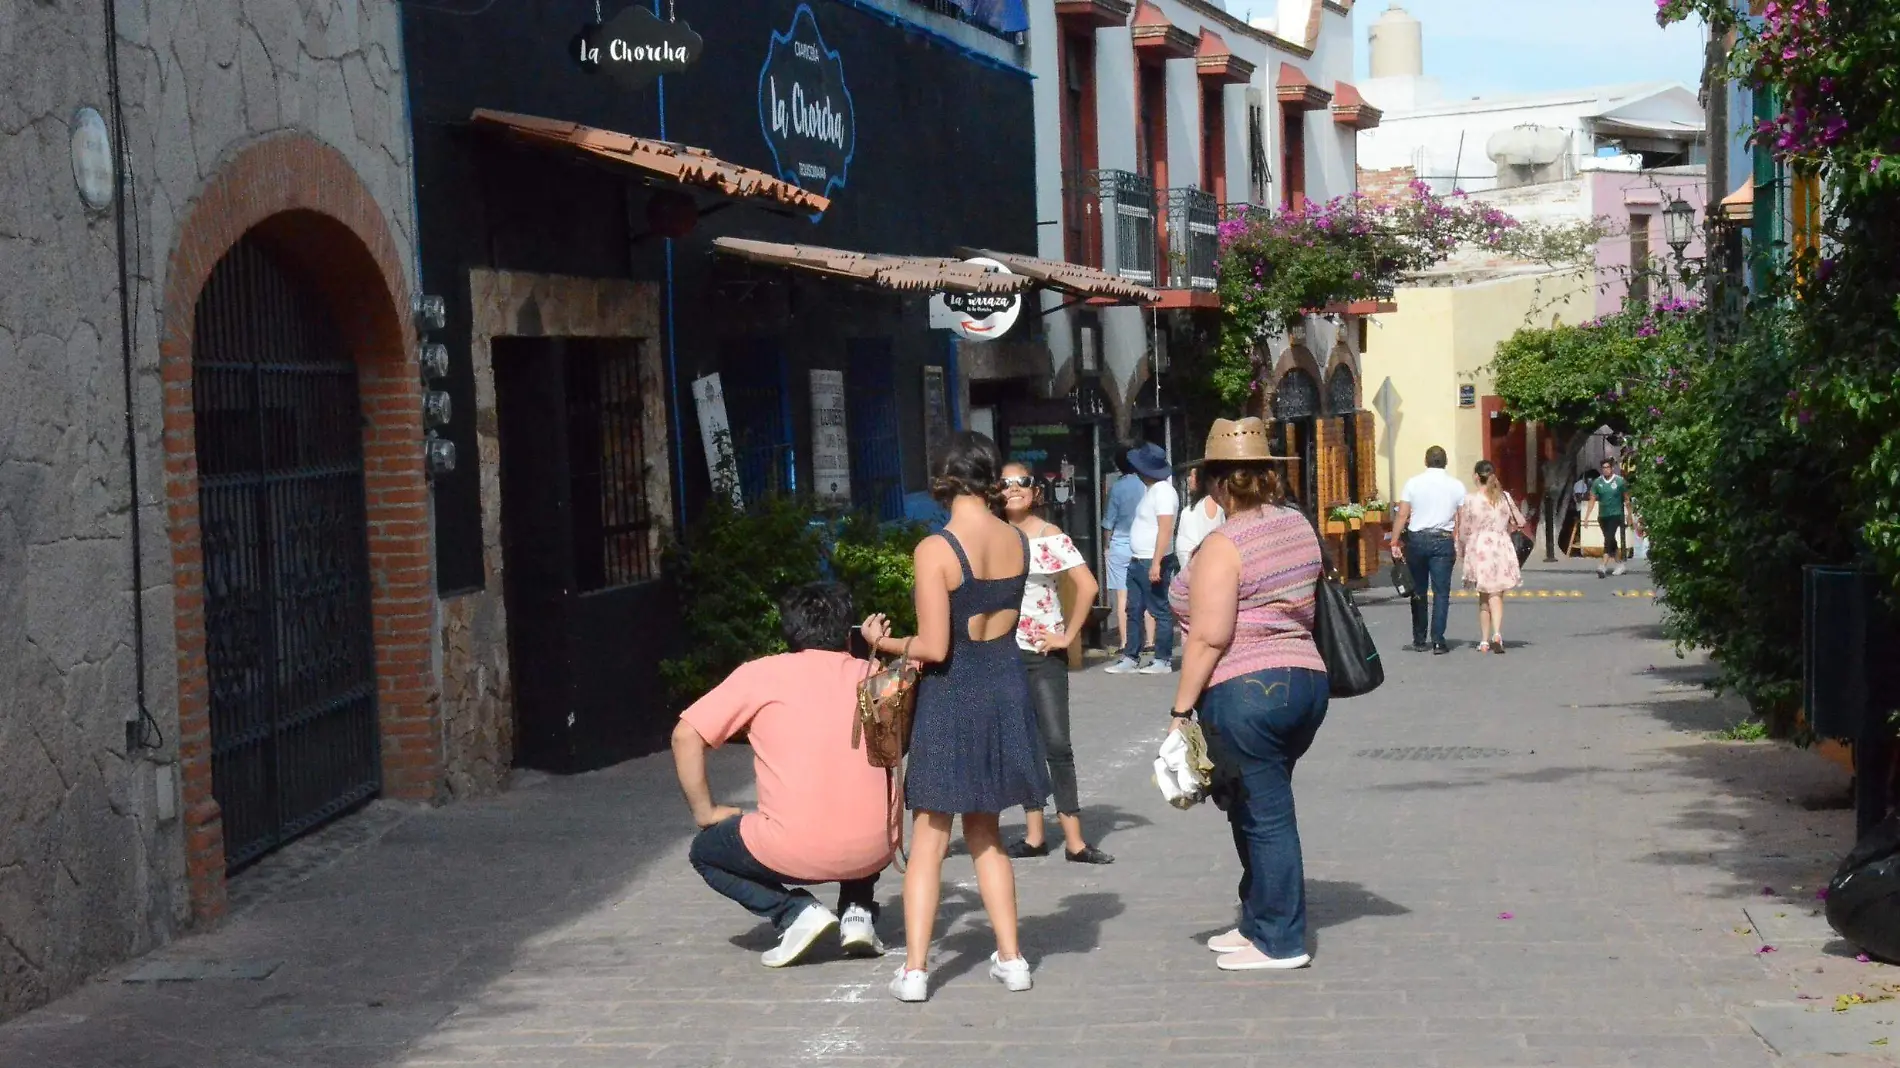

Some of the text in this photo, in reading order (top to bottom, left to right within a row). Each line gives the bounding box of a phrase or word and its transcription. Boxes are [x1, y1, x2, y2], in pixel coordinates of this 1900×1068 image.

[580, 38, 689, 64] La Chorcha
[770, 75, 844, 149] La Chorcha
[950, 294, 963, 306] La
[844, 915, 865, 924] PUMA
